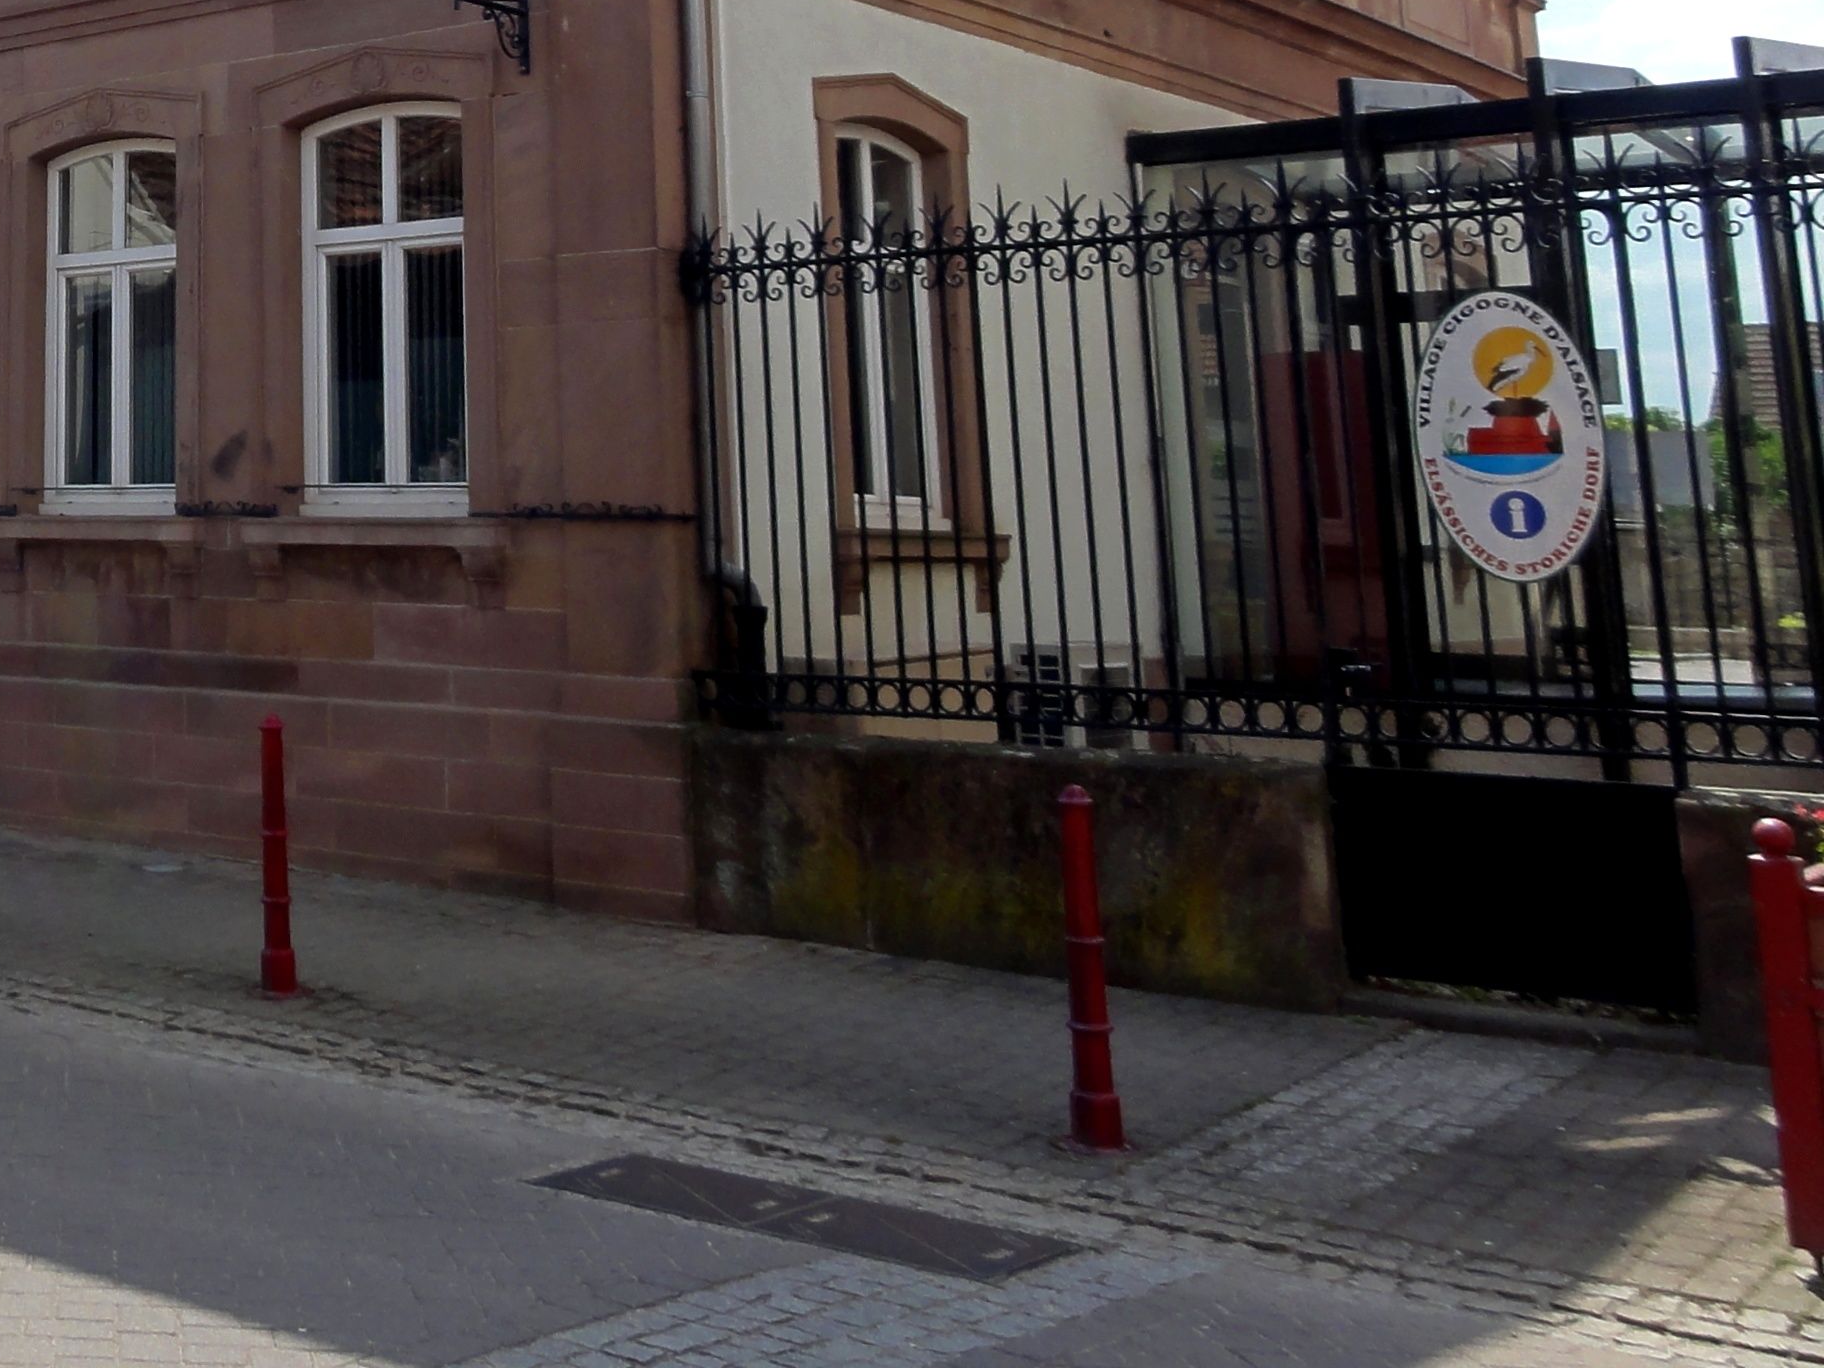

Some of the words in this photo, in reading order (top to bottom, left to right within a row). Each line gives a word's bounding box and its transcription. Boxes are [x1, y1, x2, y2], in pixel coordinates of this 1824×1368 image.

[1419, 337, 1446, 428] VILLAGE
[1443, 297, 1545, 335] CIGOGNE
[1542, 326, 1598, 428] D'ALSACE
[1514, 506, 1592, 575] STORICHE
[1582, 446, 1601, 502] DORF
